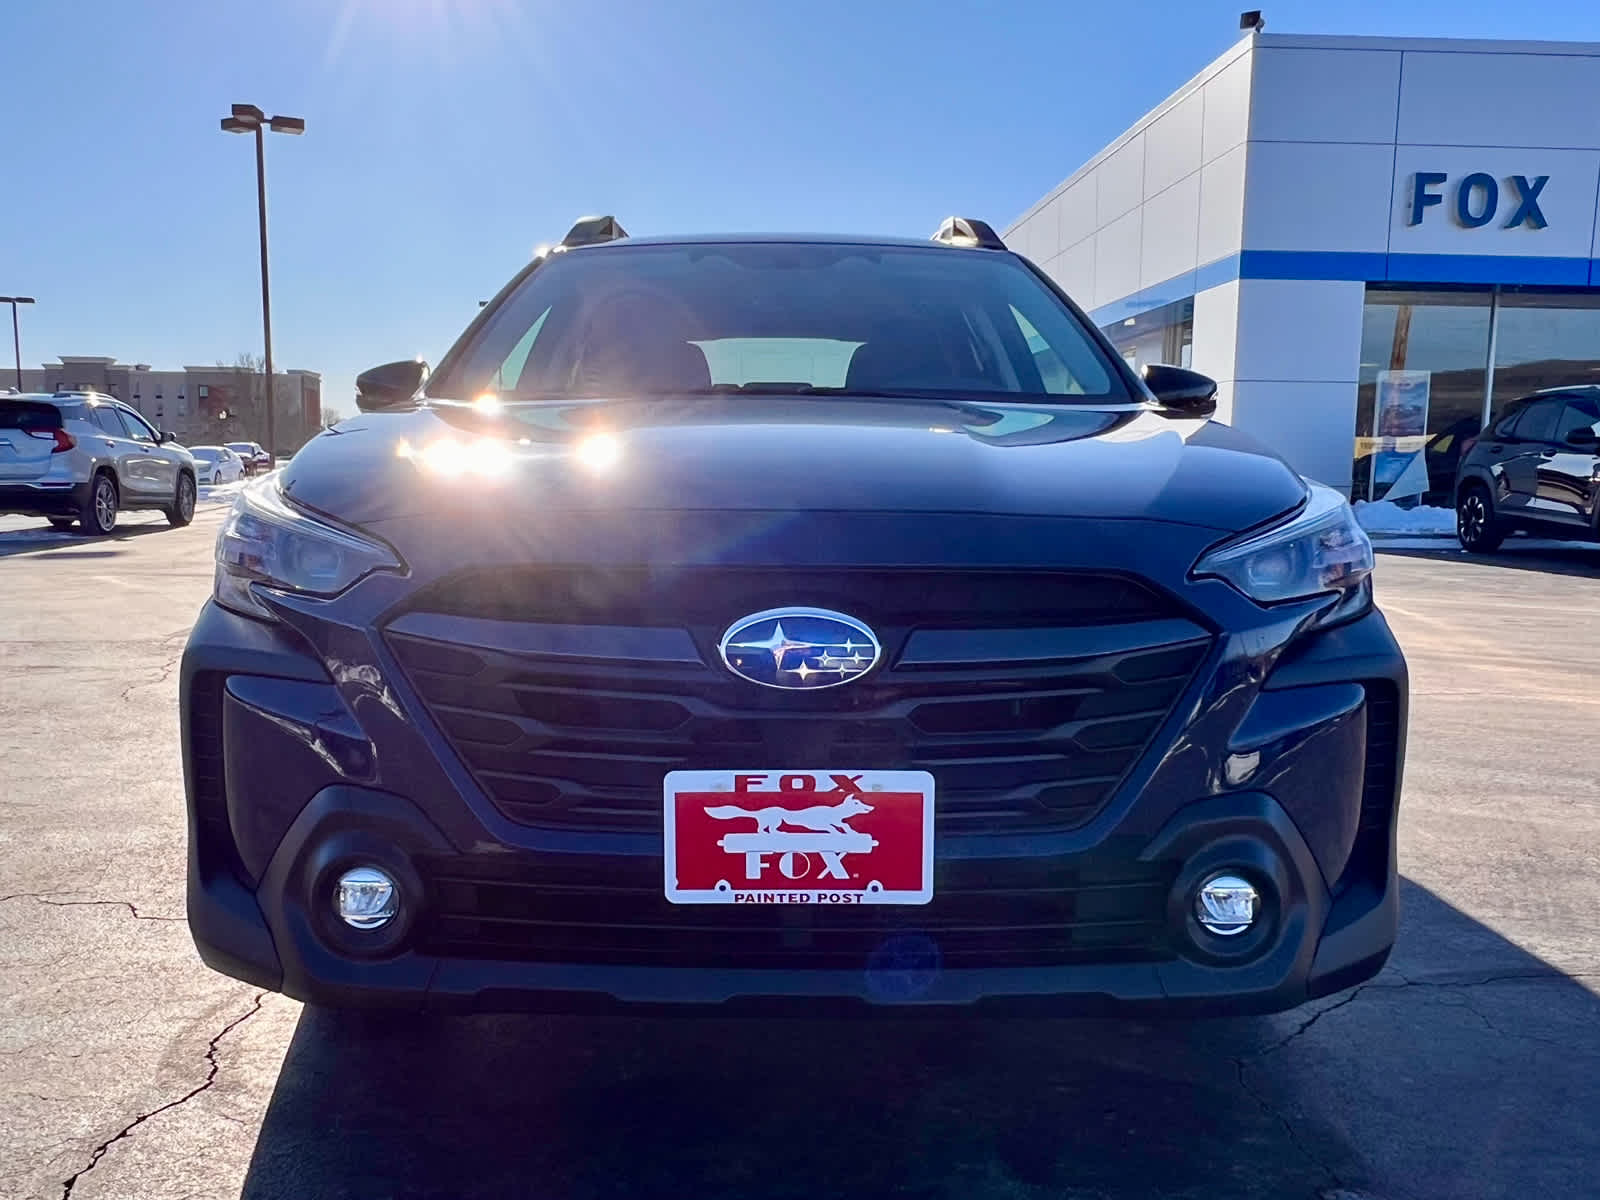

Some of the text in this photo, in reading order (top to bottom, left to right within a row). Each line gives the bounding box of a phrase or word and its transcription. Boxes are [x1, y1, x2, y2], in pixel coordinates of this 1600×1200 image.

[1409, 172, 1550, 229] FOX
[734, 774, 863, 793] FOX
[745, 852, 850, 880] FOX
[734, 893, 864, 904] PAINTED POST
